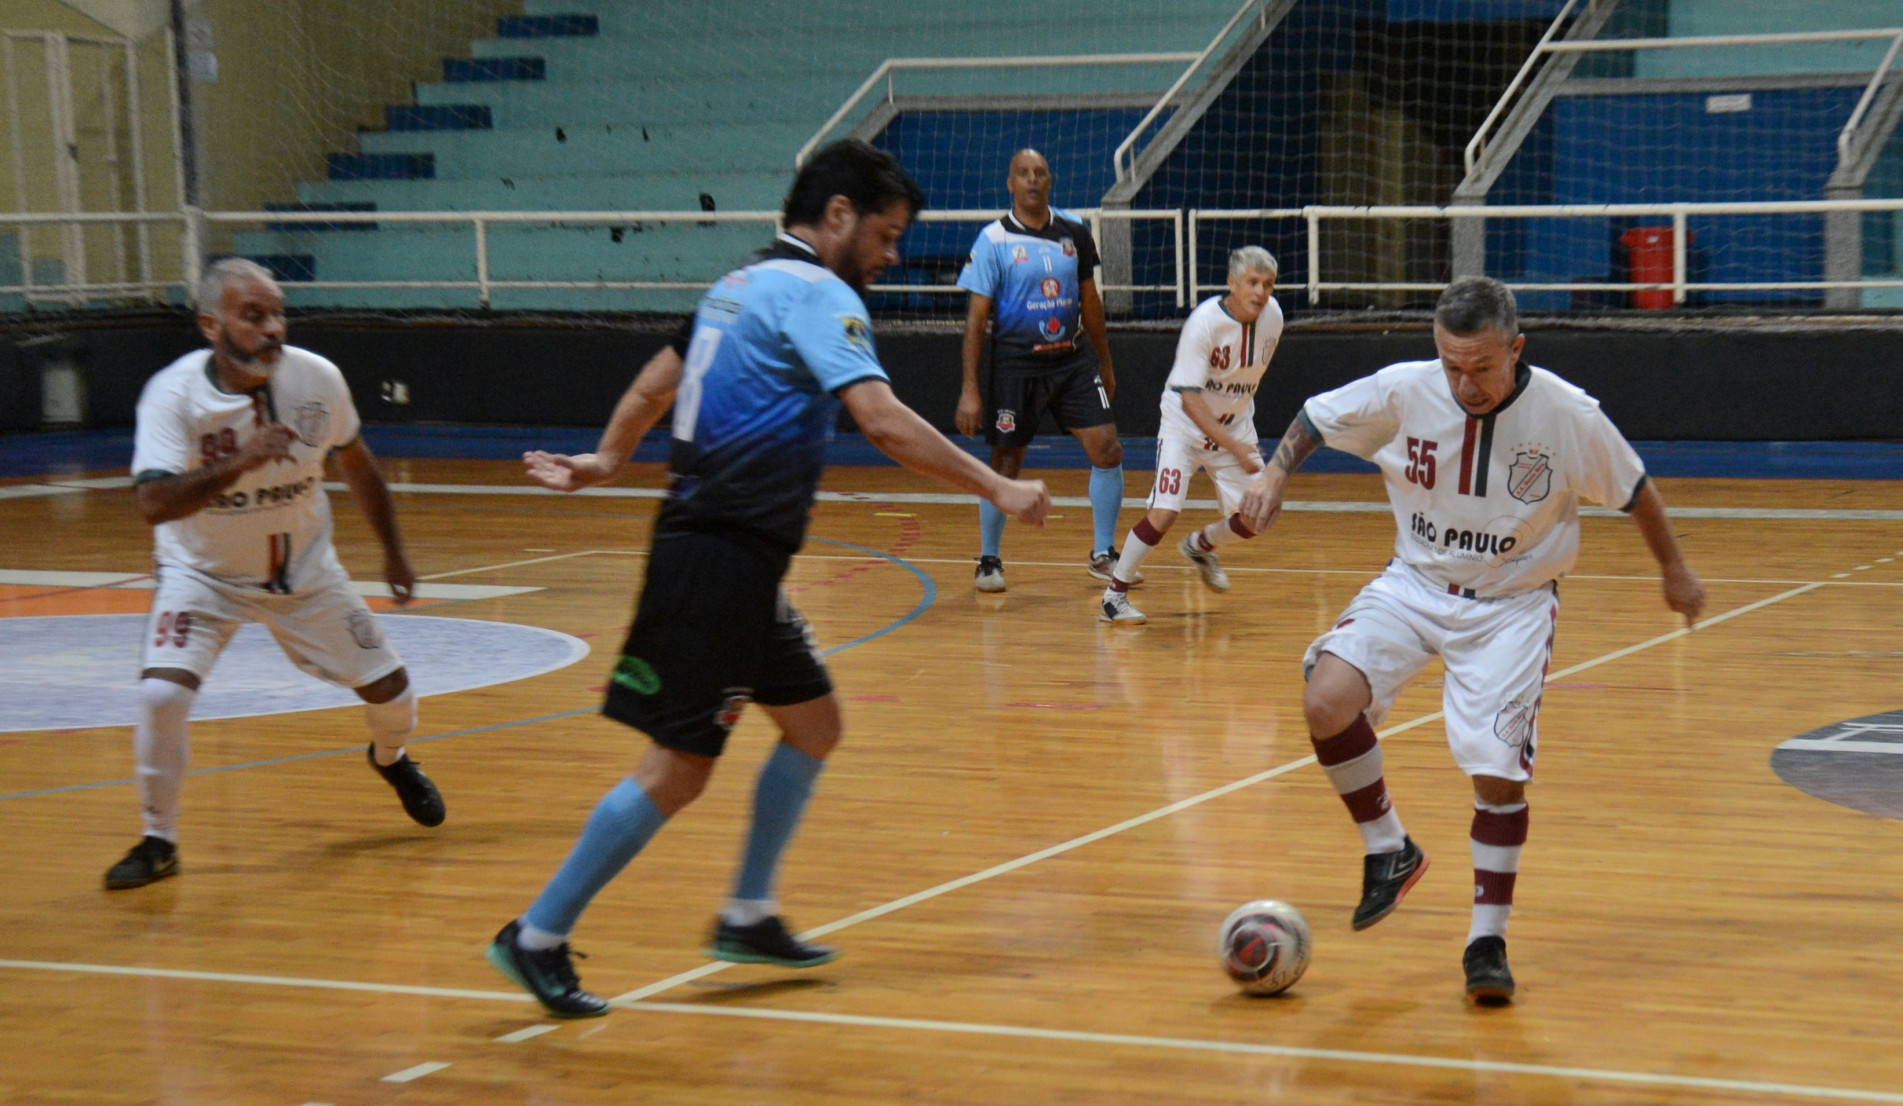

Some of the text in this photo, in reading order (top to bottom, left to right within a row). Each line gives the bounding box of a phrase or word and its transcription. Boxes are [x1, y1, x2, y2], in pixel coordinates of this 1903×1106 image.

[1210, 345, 1231, 370] 63
[1097, 386, 1110, 410] 11
[1405, 436, 1438, 490] 55
[1159, 467, 1182, 496] 63
[1411, 511, 1437, 542] SÃO
[1444, 528, 1517, 556] PAULO
[154, 610, 190, 649] 99
